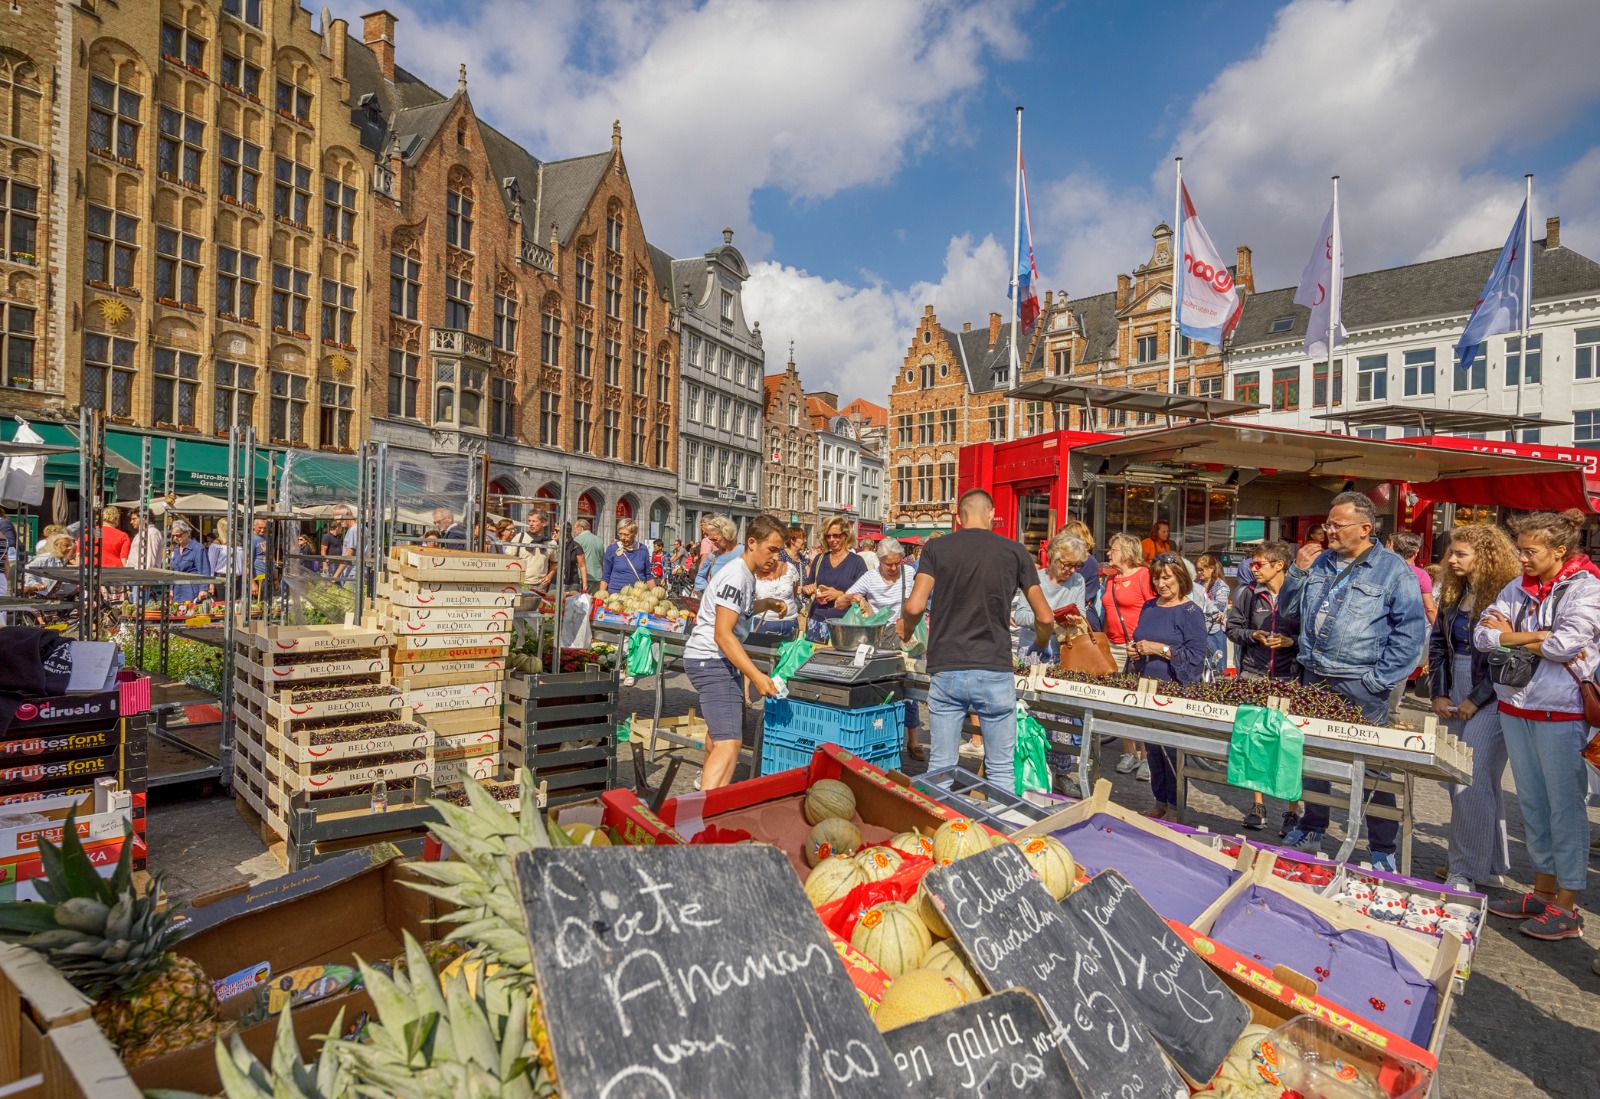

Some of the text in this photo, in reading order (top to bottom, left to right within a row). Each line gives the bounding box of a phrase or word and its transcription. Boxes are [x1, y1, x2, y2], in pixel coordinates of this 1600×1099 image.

[314, 638, 356, 647] BELORTA
[310, 664, 352, 673] BELORTA
[1069, 685, 1106, 696] BELORTA
[39, 704, 100, 719] Ciruelo
[327, 701, 371, 711] BELORTA
[1186, 703, 1230, 716] BELORTA
[1327, 724, 1380, 739] BELORTA
[348, 740, 393, 752] BELORTA
[349, 768, 394, 781] BELOTA
[20, 824, 87, 842] CRISTA
[1232, 961, 1284, 997] LES
[1290, 992, 1389, 1048] RIVES
